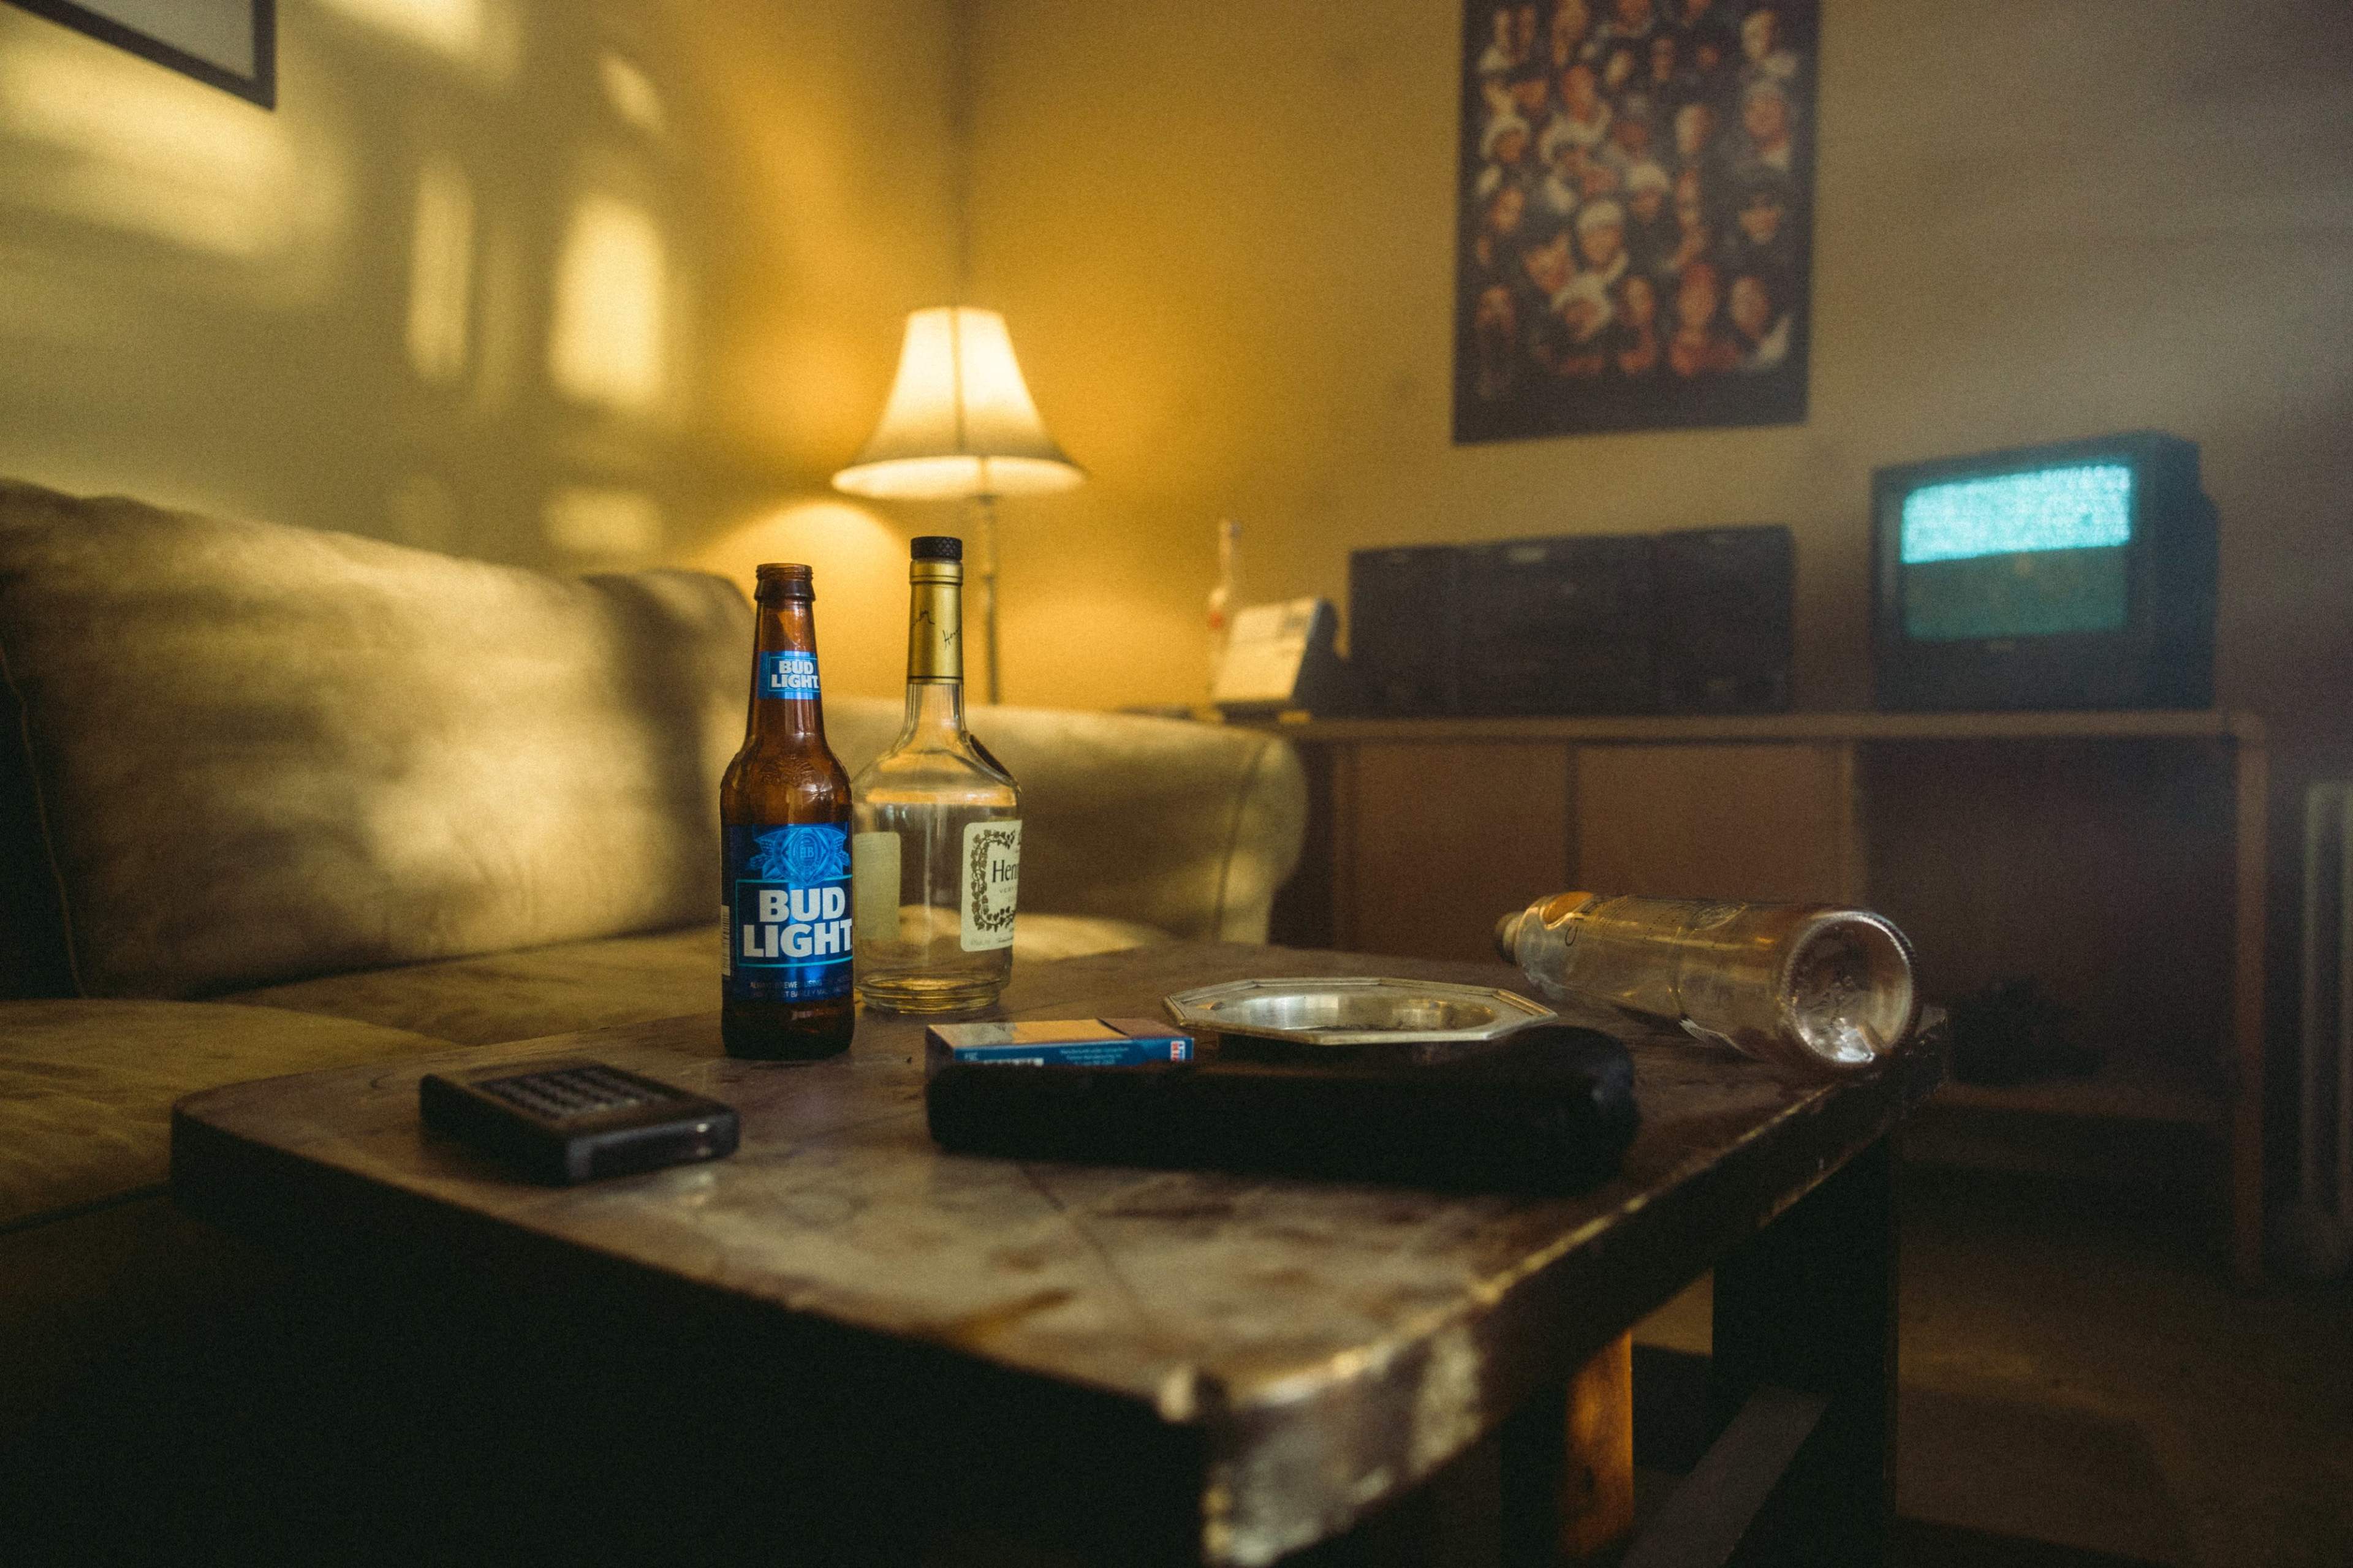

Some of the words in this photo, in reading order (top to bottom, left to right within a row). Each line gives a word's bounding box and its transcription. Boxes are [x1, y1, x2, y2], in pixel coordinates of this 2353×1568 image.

[779, 660, 814, 675] BUD
[771, 674, 819, 688] LIGHT
[992, 860, 1020, 883] Hen
[759, 887, 846, 923] BUD
[743, 918, 852, 958] LIGHT
